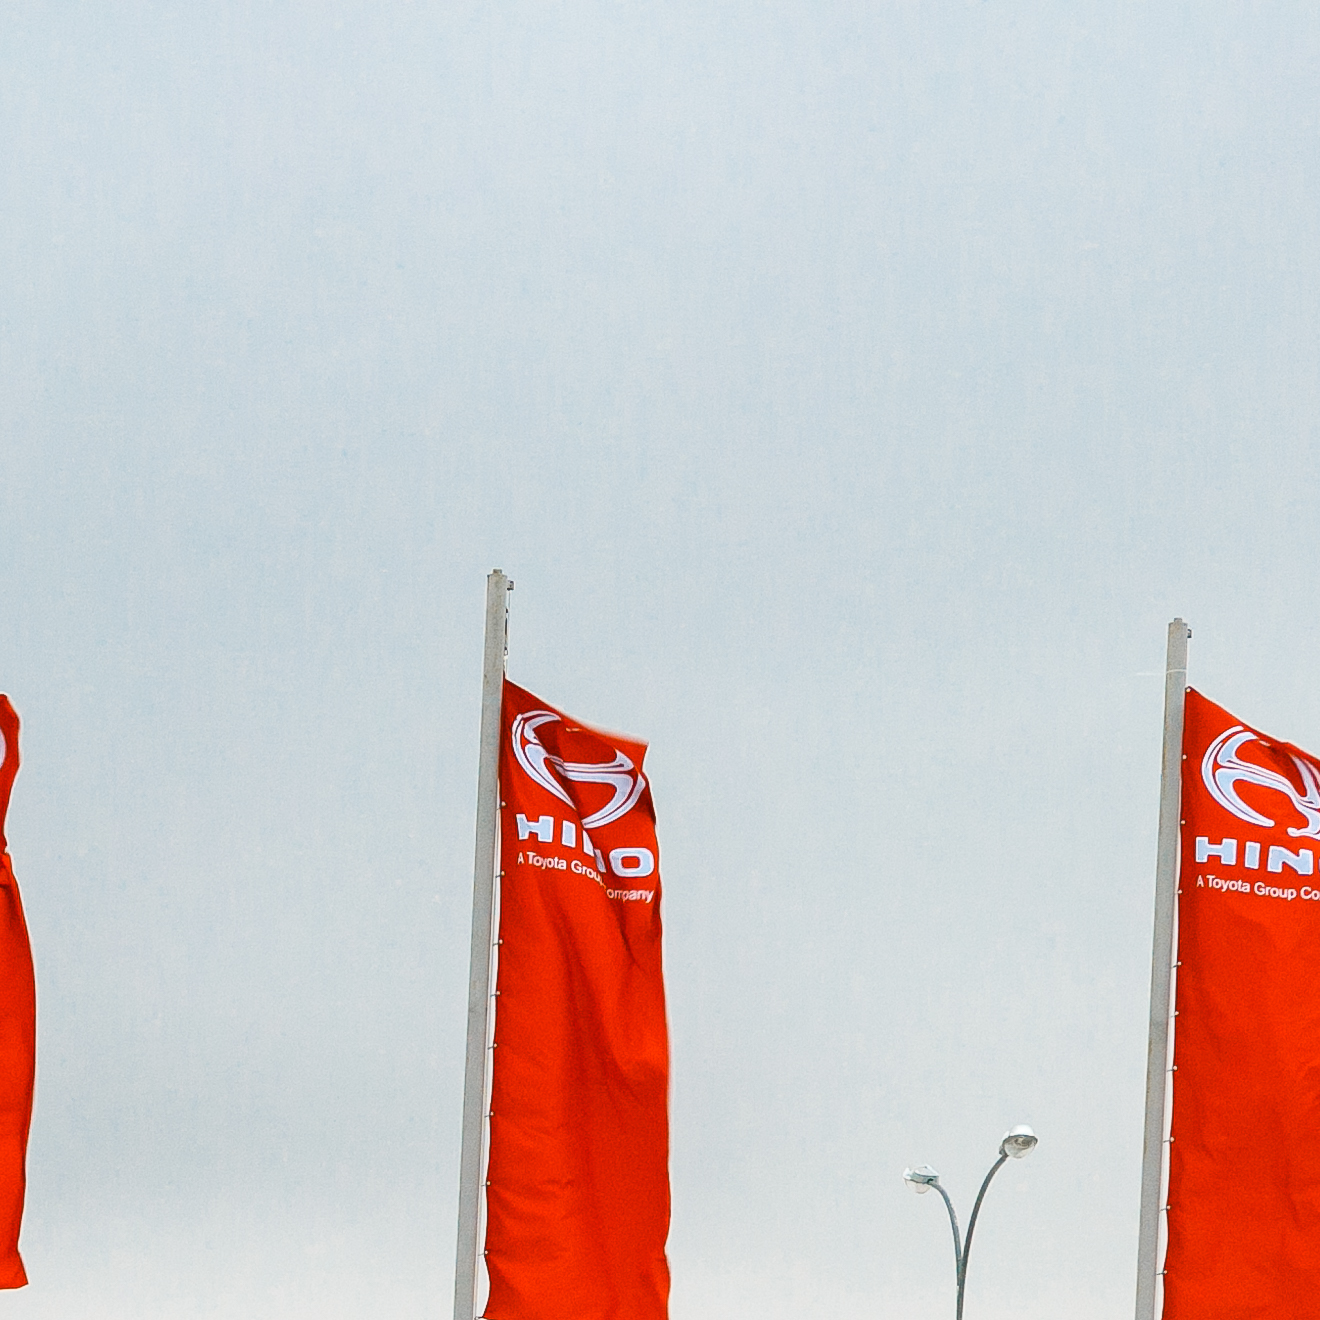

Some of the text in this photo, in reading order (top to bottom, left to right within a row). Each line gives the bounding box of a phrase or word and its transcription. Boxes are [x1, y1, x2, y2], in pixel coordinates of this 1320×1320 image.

[517, 851, 655, 903] A Toyota Grou ompany
[1196, 874, 1204, 888] A
[1206, 874, 1251, 892] Toyota
[1254, 882, 1297, 901] Group
